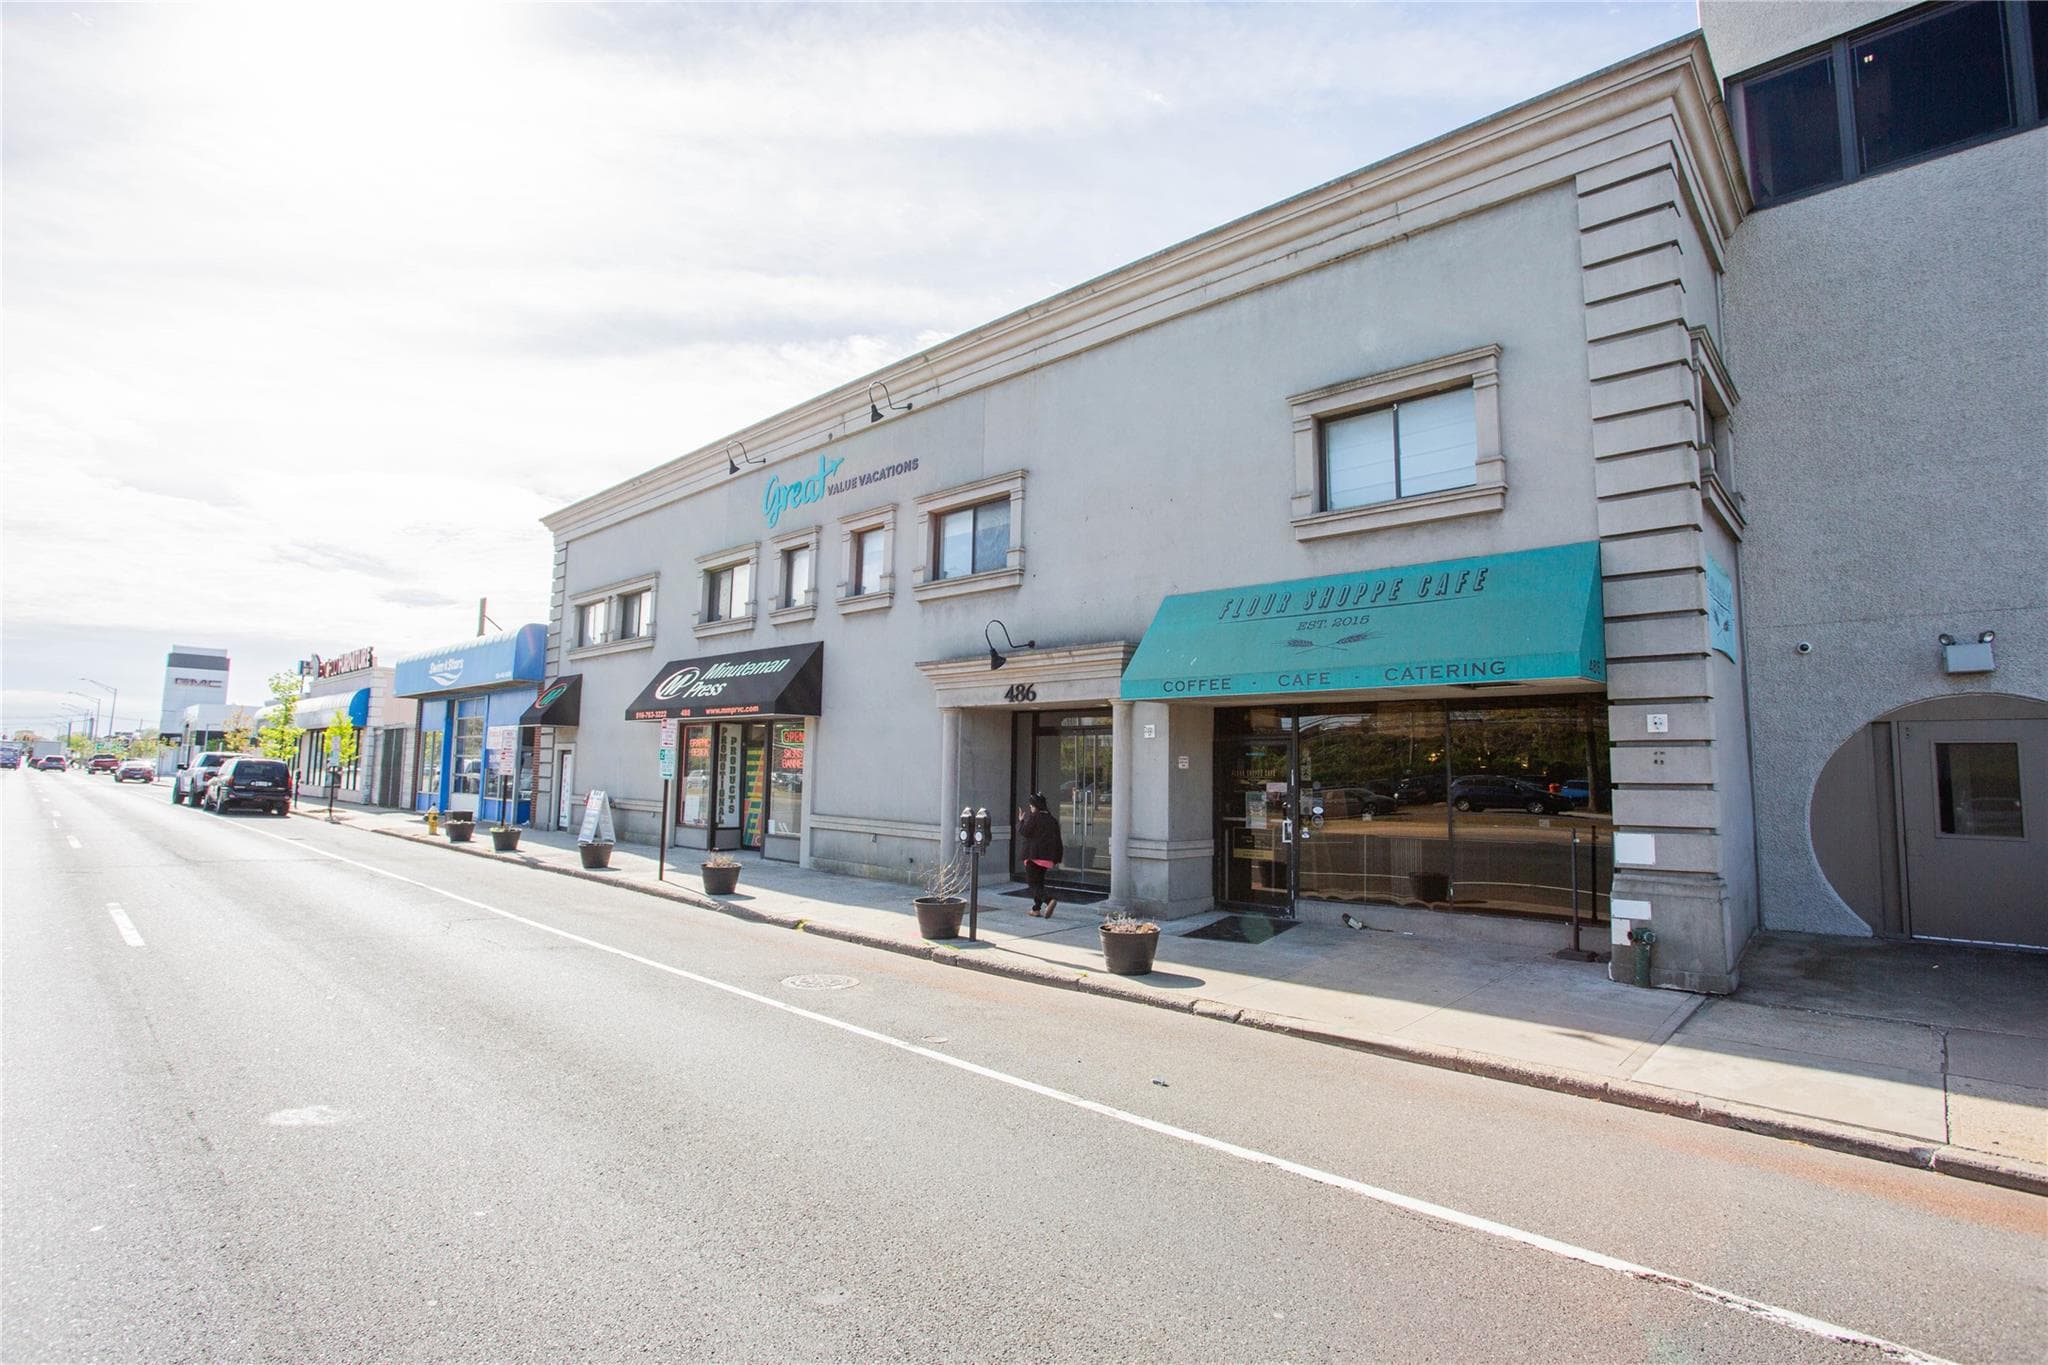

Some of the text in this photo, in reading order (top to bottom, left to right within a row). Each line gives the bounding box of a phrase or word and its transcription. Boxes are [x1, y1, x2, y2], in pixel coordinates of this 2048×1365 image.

[762, 454, 919, 529] Great VALUE VACATIONS
[1218, 567, 1488, 620] FLOUR SHOPPE CAFE
[1296, 615, 1370, 631] EST. 2015
[701, 658, 790, 681] Minuteman
[1163, 661, 1506, 693] COFFEE CAFE CATERING
[174, 677, 222, 688] GMC
[682, 681, 727, 698] Press
[1004, 683, 1037, 702] 486
[783, 730, 805, 743] OPEN
[718, 727, 728, 824] PROMOTIONAL
[728, 736, 737, 814] PRODUCTS
